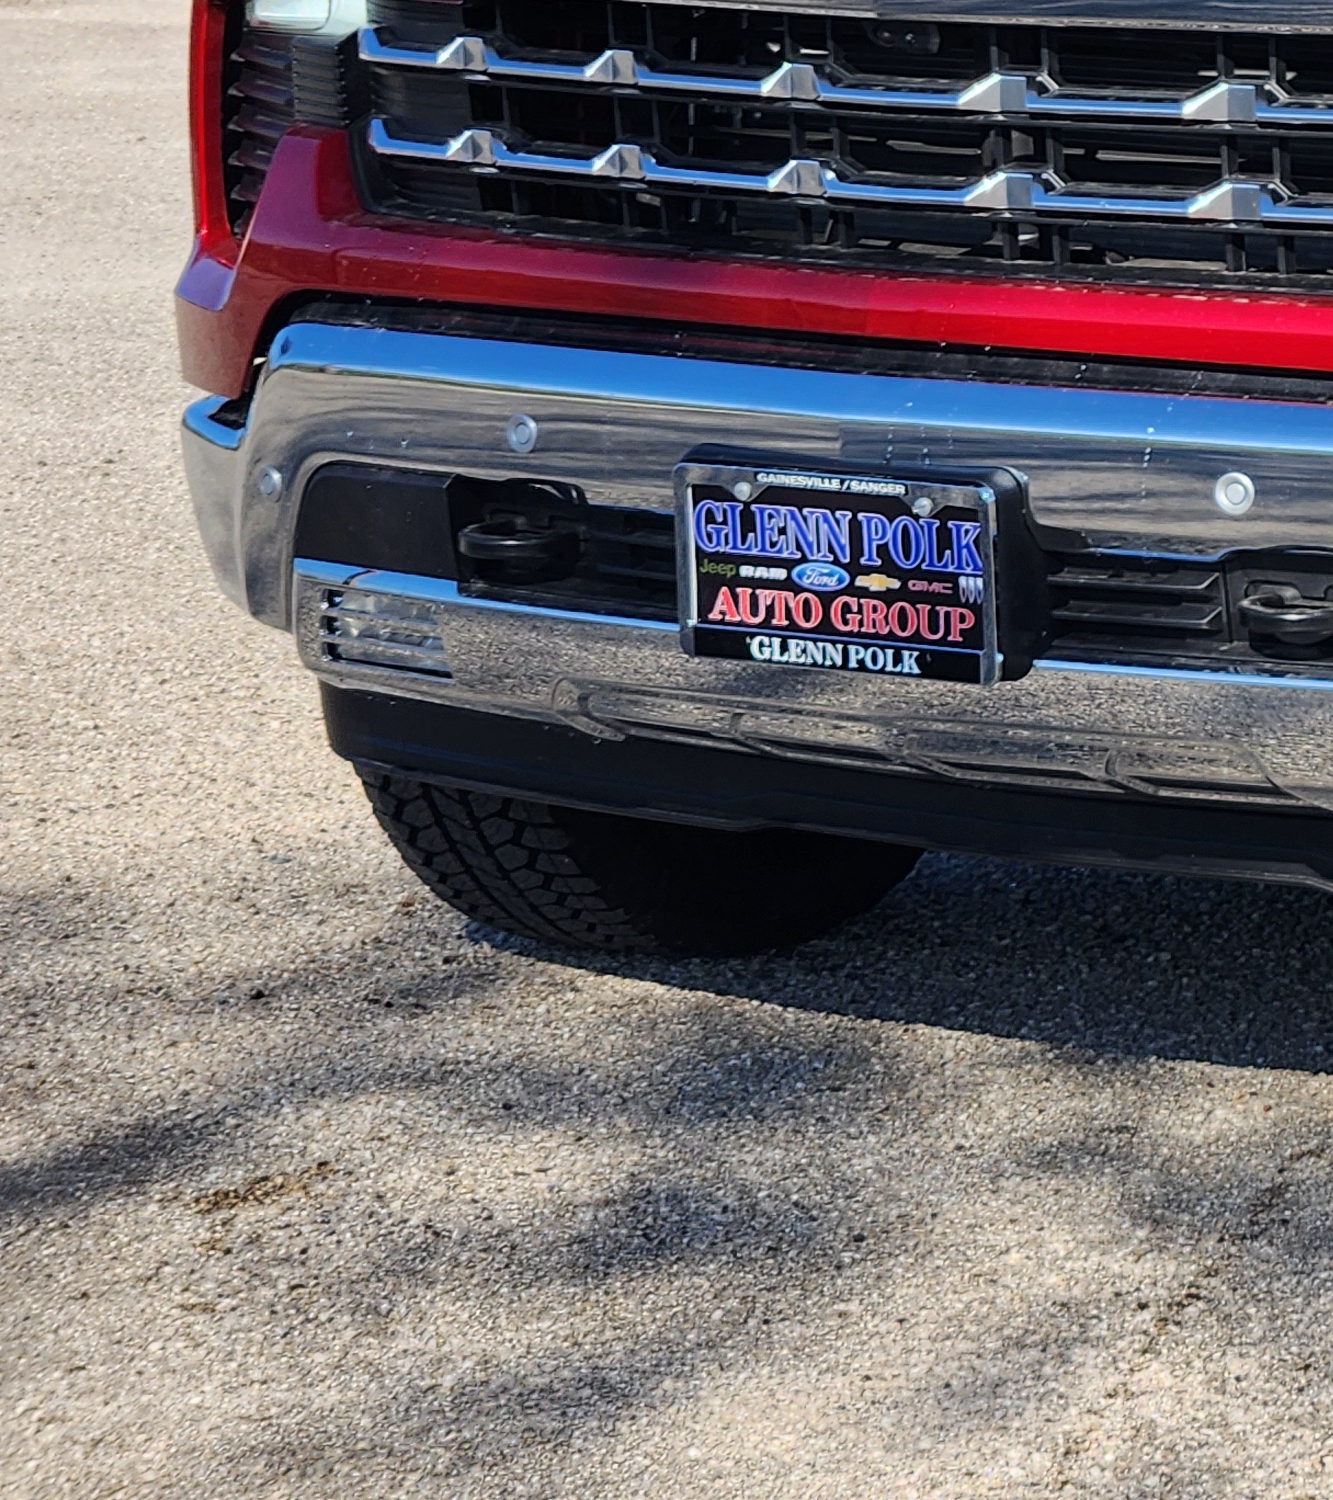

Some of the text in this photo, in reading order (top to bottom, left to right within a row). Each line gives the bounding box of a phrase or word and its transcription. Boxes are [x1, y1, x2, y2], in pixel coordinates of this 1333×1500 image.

[756, 472, 842, 489] GAINESVILLE
[851, 480, 906, 495] SANGER
[694, 500, 983, 575] GLENN POLK
[700, 559, 954, 594] Jeep RAM Ford GMC
[708, 586, 976, 642] AUTO GROUP
[750, 635, 922, 675] GLENN POLK
